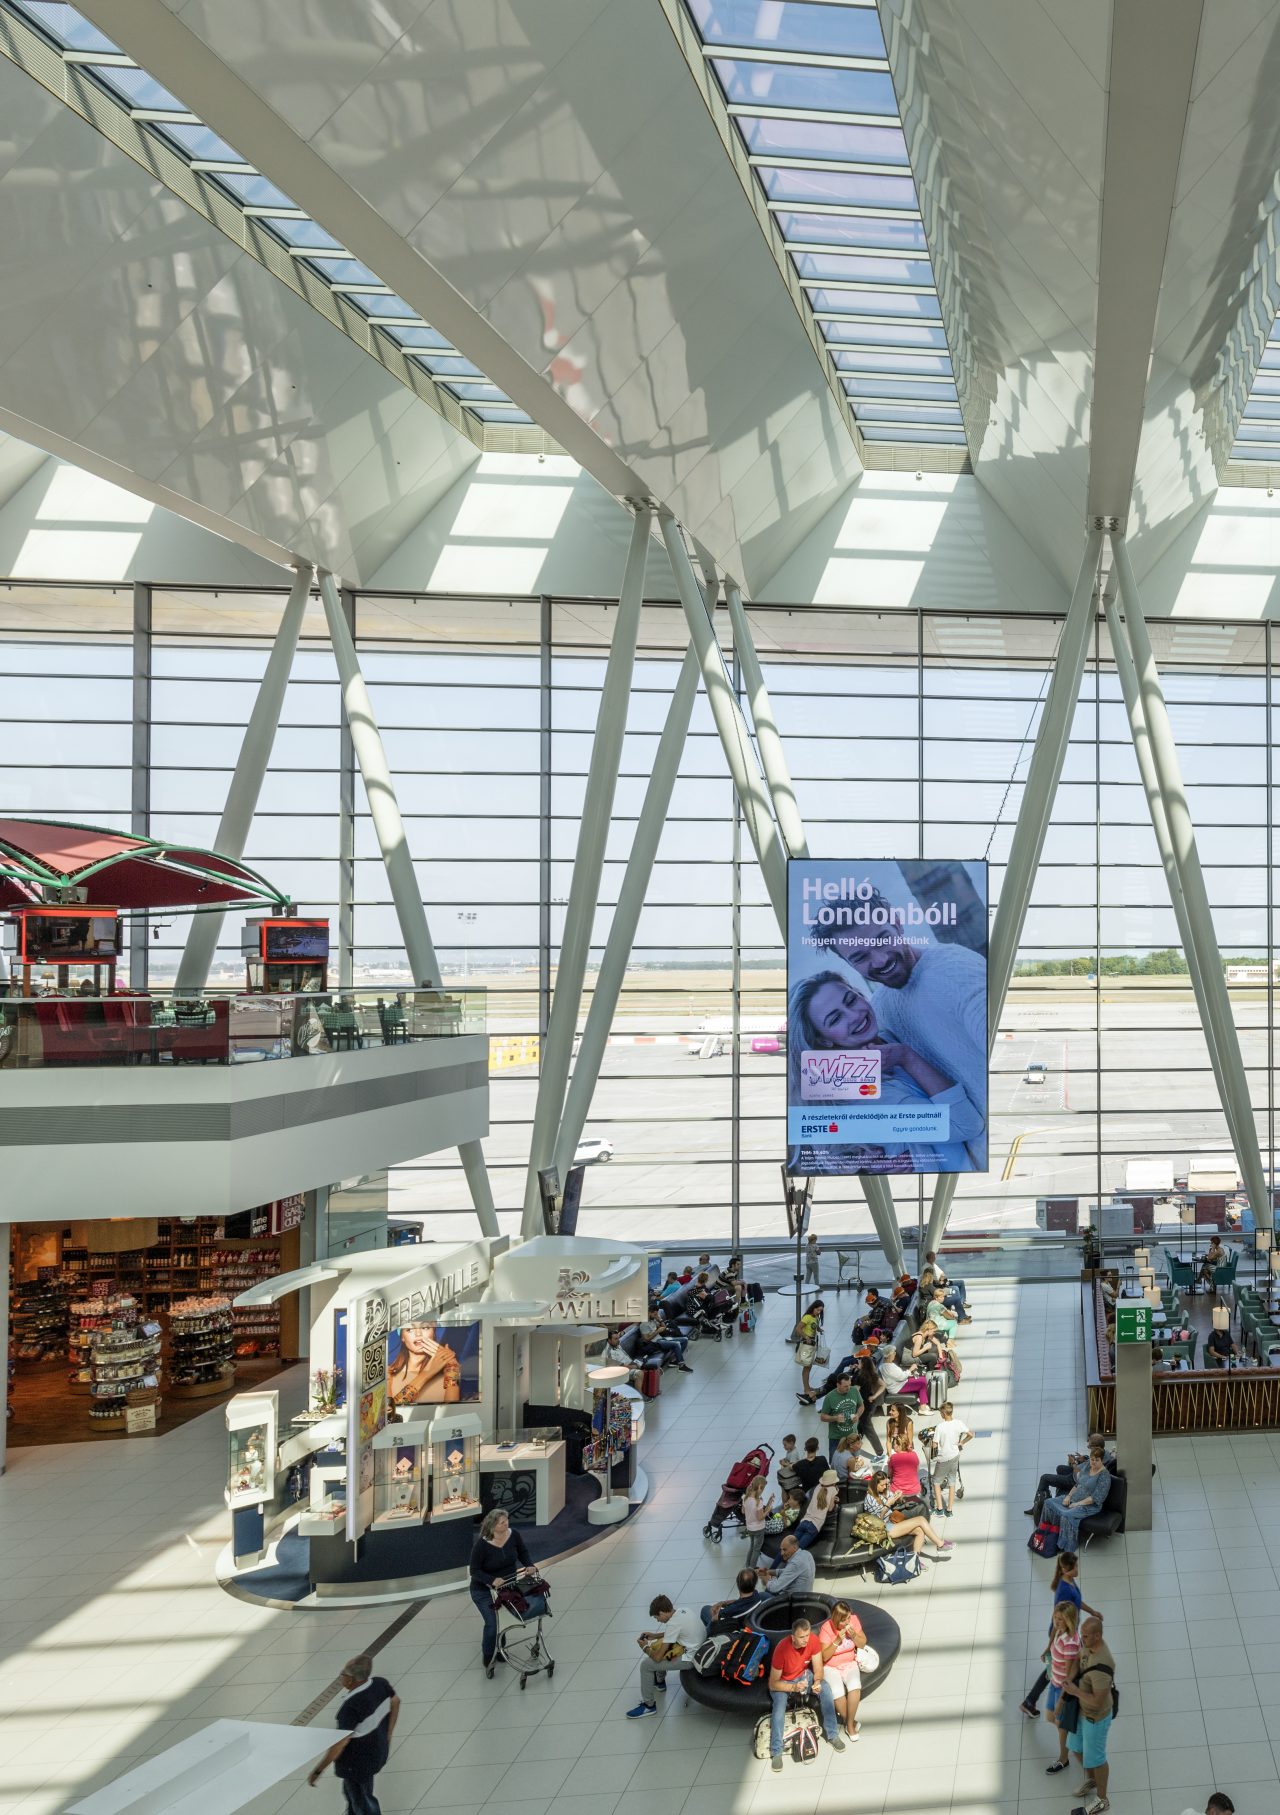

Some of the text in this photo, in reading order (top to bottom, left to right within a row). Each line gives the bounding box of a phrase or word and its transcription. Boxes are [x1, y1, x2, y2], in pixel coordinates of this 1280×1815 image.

[802, 877, 873, 901] Helló
[802, 902, 957, 925] Londonból!
[801, 936, 929, 947] Ingyen repjeggyel jöttünk
[801, 1125, 828, 1133] ERSTE
[387, 1261, 479, 1332] FREYWILLE
[528, 1298, 641, 1319] YWILLE
